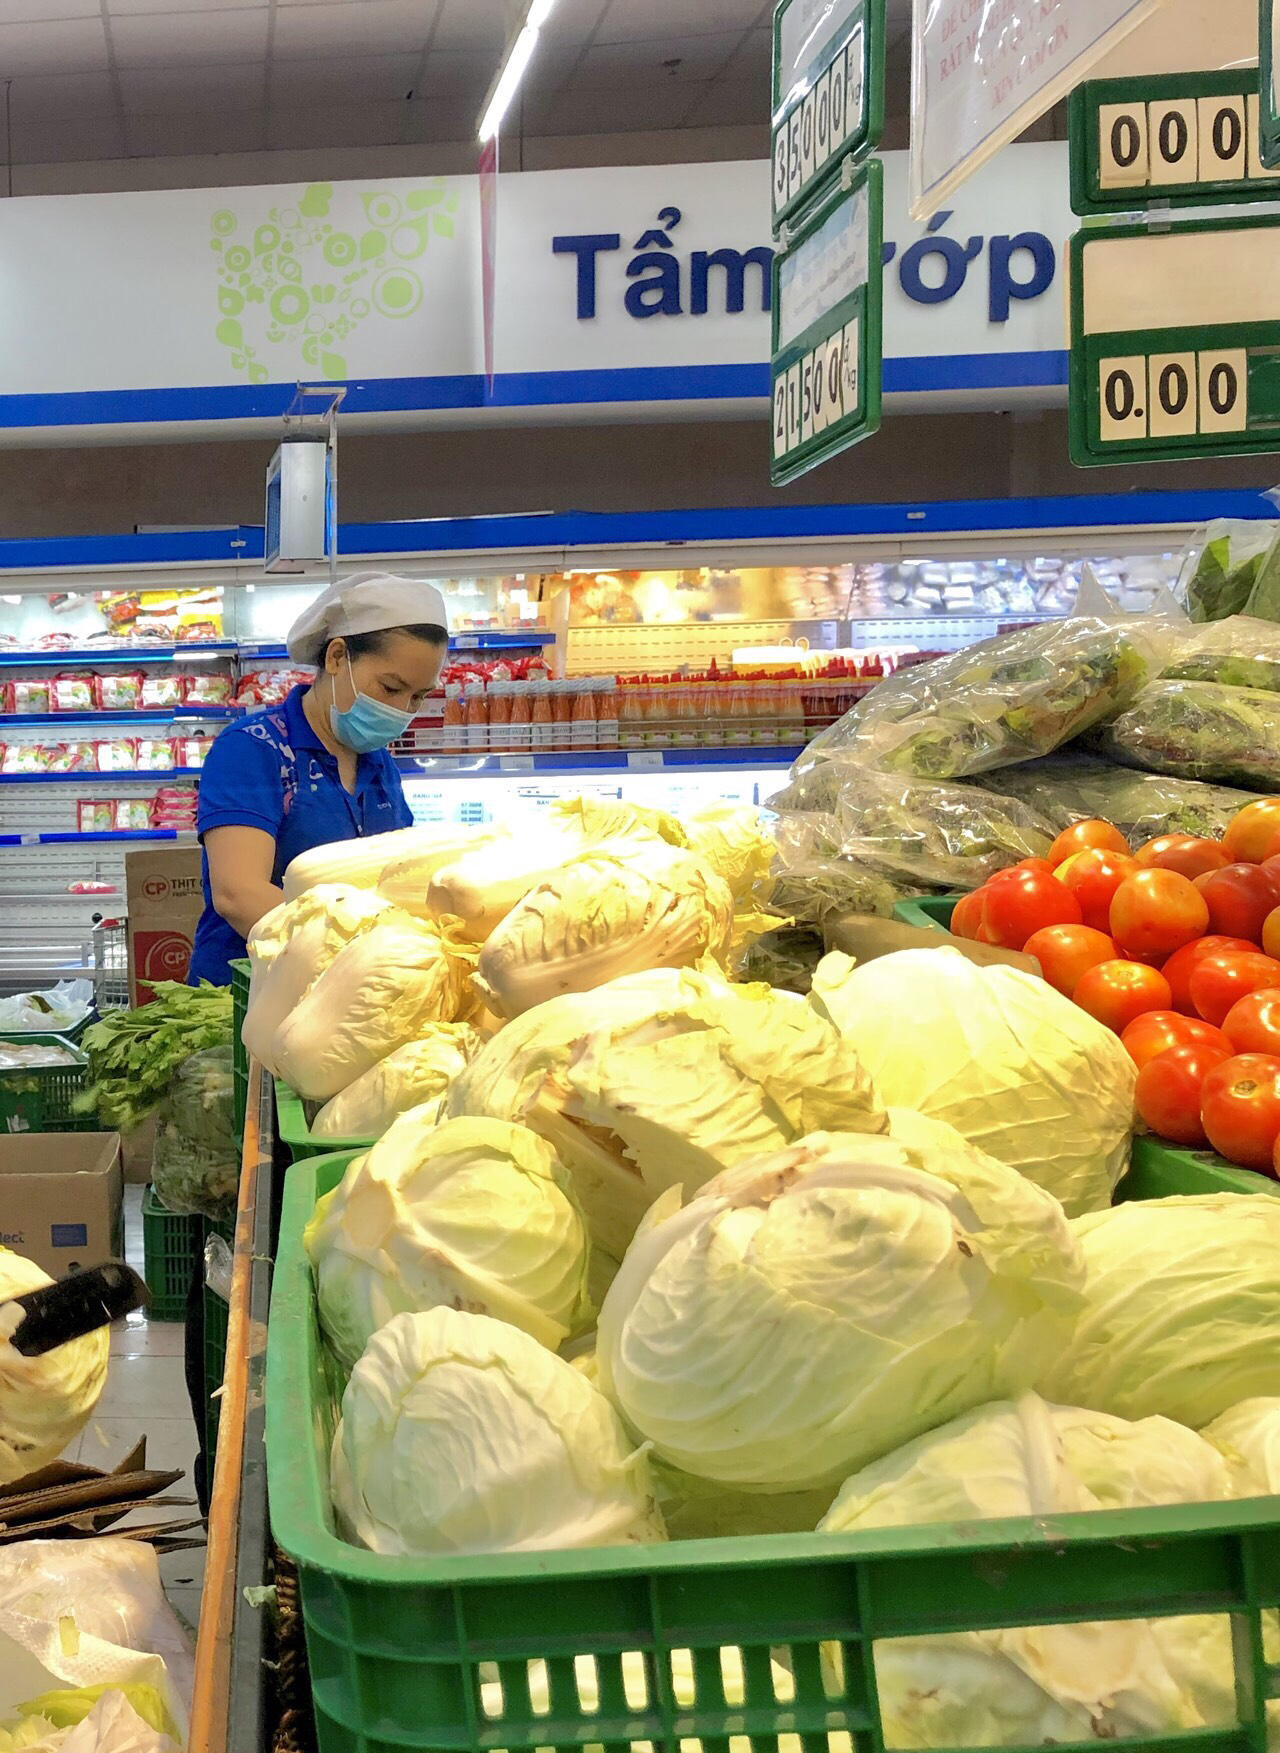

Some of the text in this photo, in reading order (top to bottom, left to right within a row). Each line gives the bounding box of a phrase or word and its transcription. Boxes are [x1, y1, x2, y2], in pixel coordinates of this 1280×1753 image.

[552, 206, 772, 320] Tẩm
[880, 210, 1056, 323] ớp
[1105, 362, 1238, 421] 0.00
[145, 881, 167, 895] CP
[164, 951, 186, 965] CP
